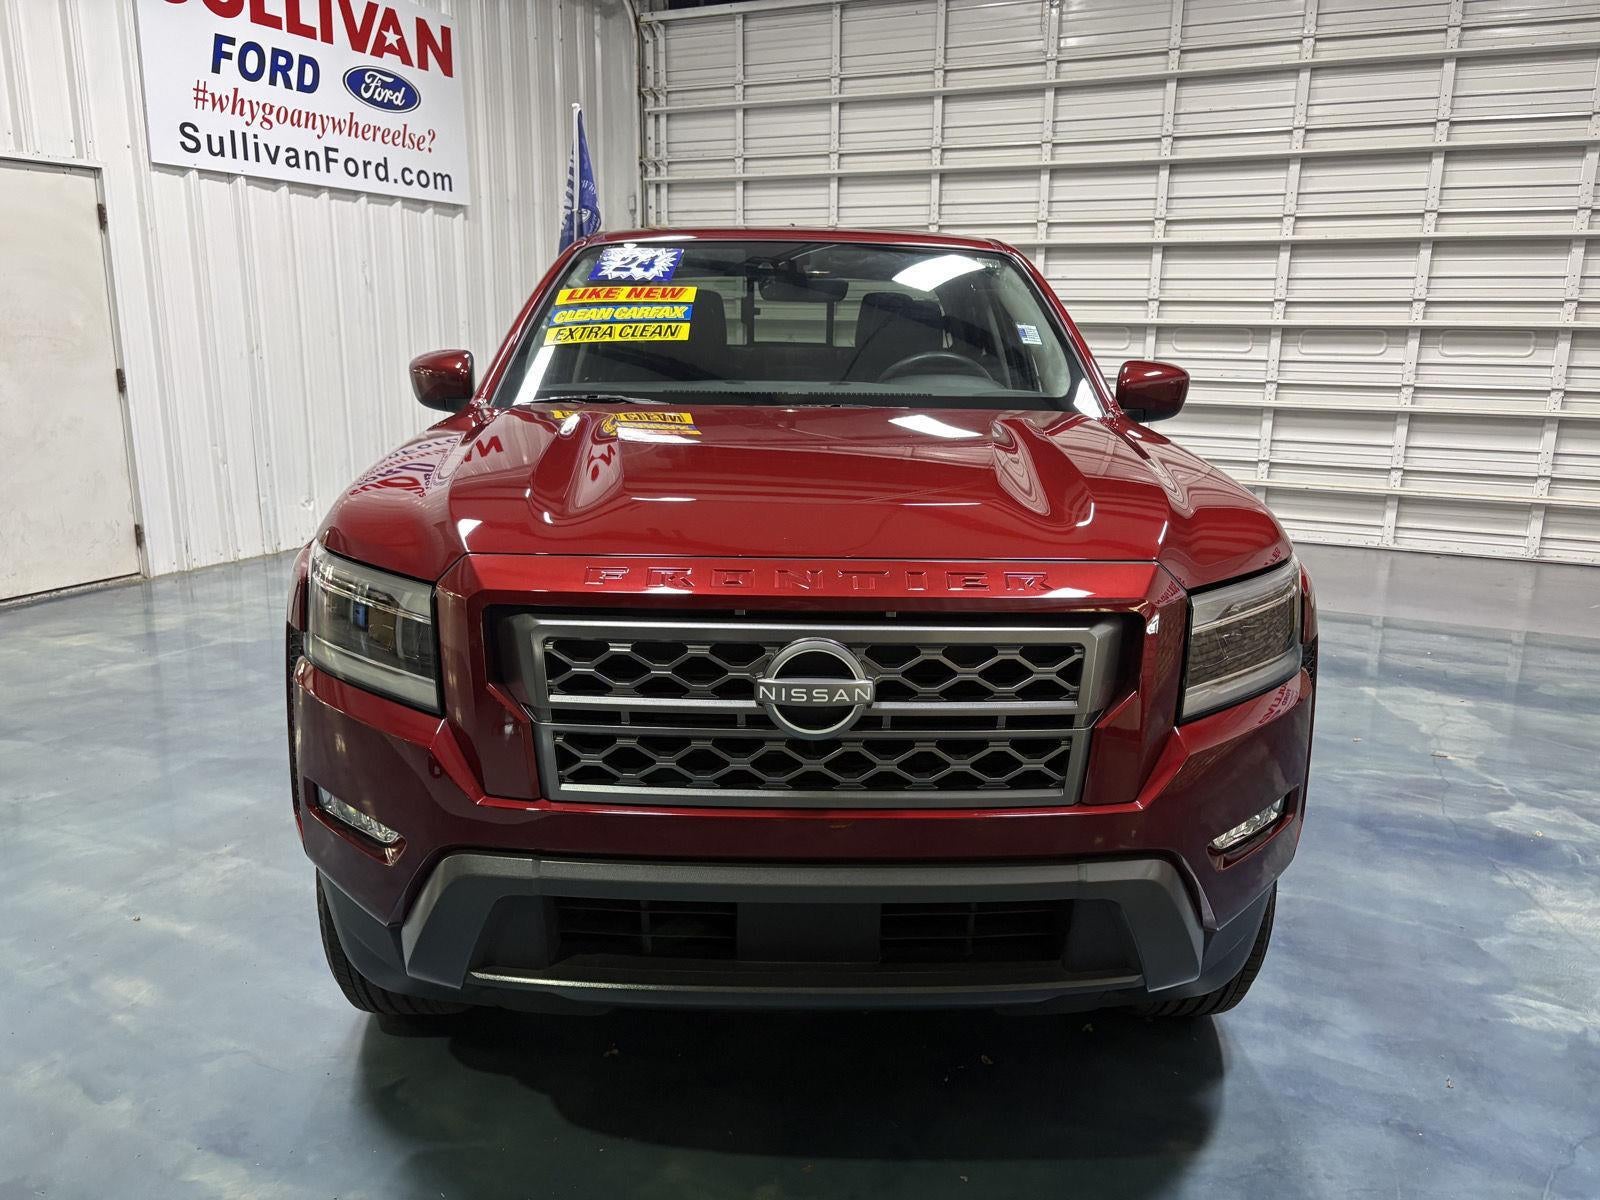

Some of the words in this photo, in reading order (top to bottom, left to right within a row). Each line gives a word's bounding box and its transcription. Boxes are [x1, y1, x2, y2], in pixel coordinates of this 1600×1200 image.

[211, 33, 320, 94] FORD
[360, 70, 406, 106] Ford
[192, 79, 436, 154] #whygoanywhereelse?
[179, 122, 453, 192] SullivanFord.com
[566, 287, 622, 301] LIKE
[626, 286, 687, 300] NEW
[553, 308, 615, 323] CLEAN
[614, 306, 688, 319] CARFAX
[554, 326, 614, 341] EXTRA
[619, 324, 681, 339] CLEAN
[584, 566, 1055, 592] FRONTIER
[759, 684, 872, 702] NISSAN
